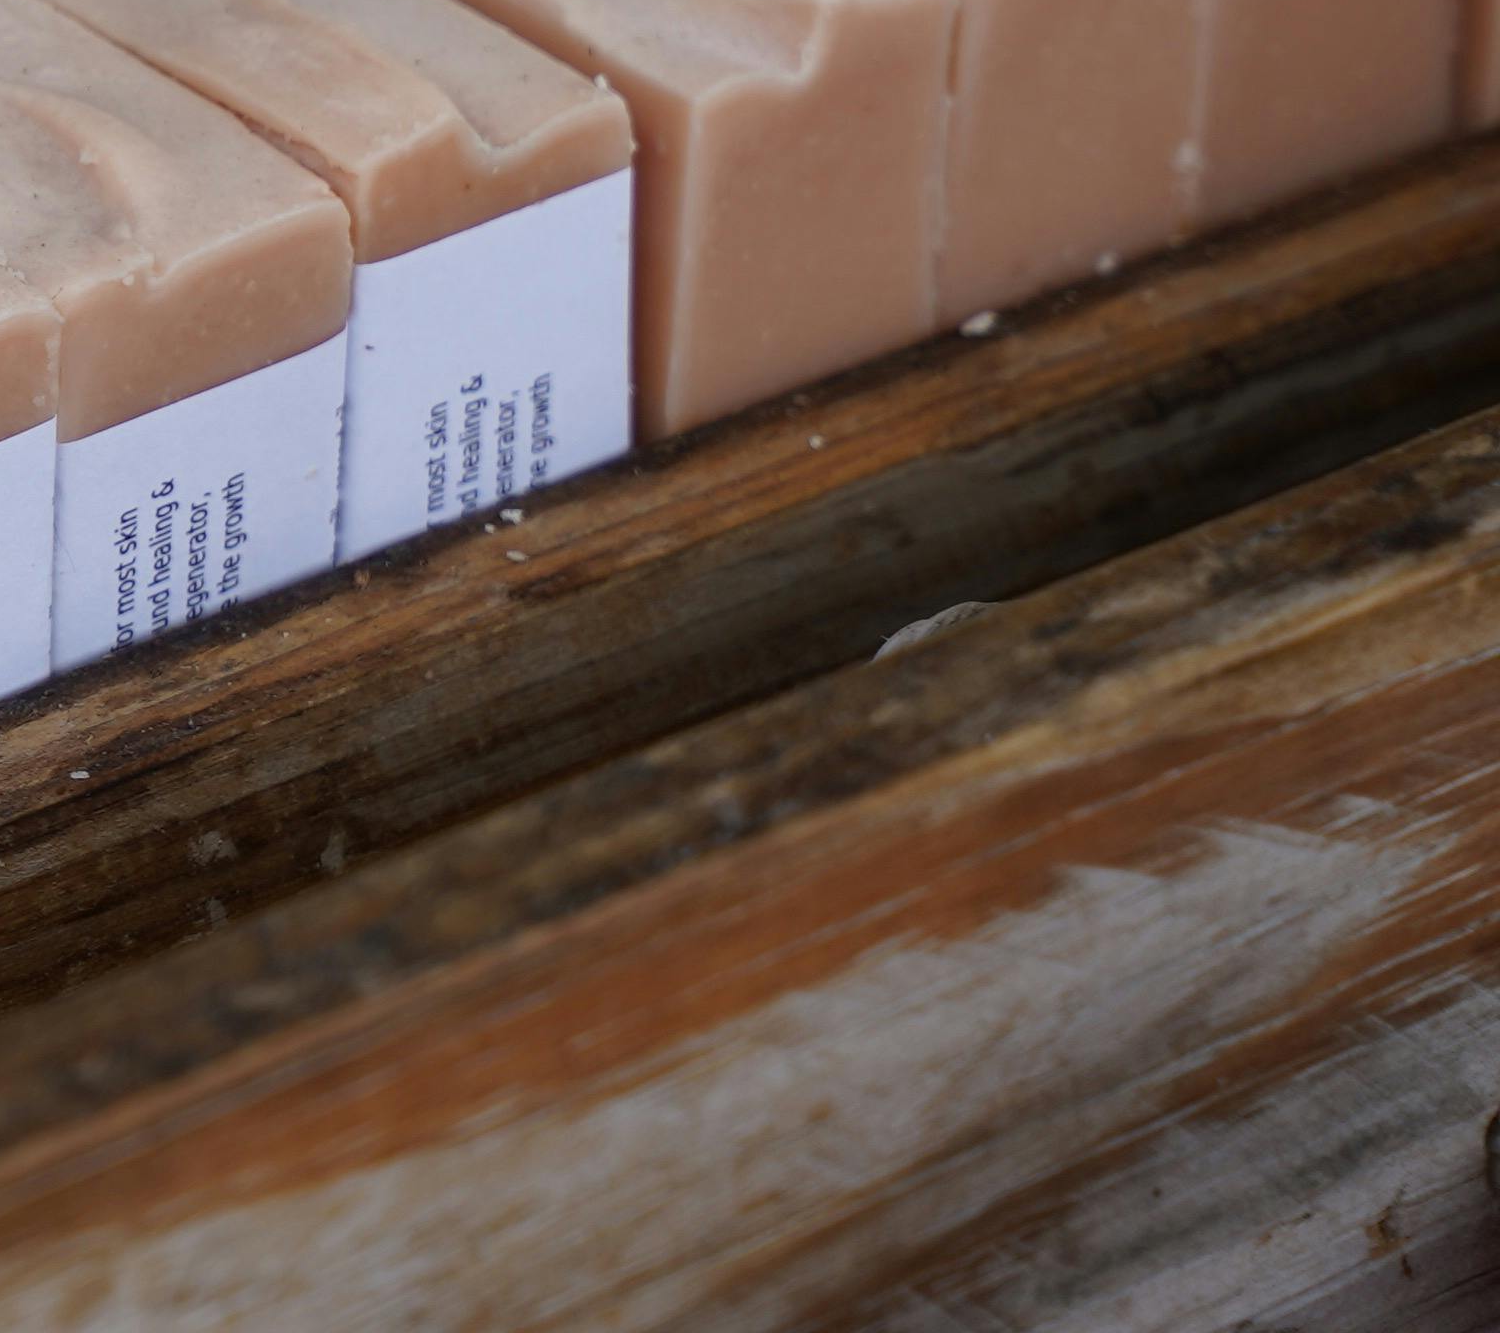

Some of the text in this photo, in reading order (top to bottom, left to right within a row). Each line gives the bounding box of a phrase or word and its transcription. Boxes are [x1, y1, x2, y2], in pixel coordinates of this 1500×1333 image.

[460, 374, 483, 394] &
[529, 372, 555, 455] growth
[424, 400, 448, 514] most skin
[457, 397, 487, 487] healing
[114, 507, 138, 555] skin
[221, 472, 247, 550] growth
[114, 556, 137, 616] most
[147, 478, 179, 634] und healing &
[186, 492, 212, 622] egenerator,
[216, 553, 240, 594] the
